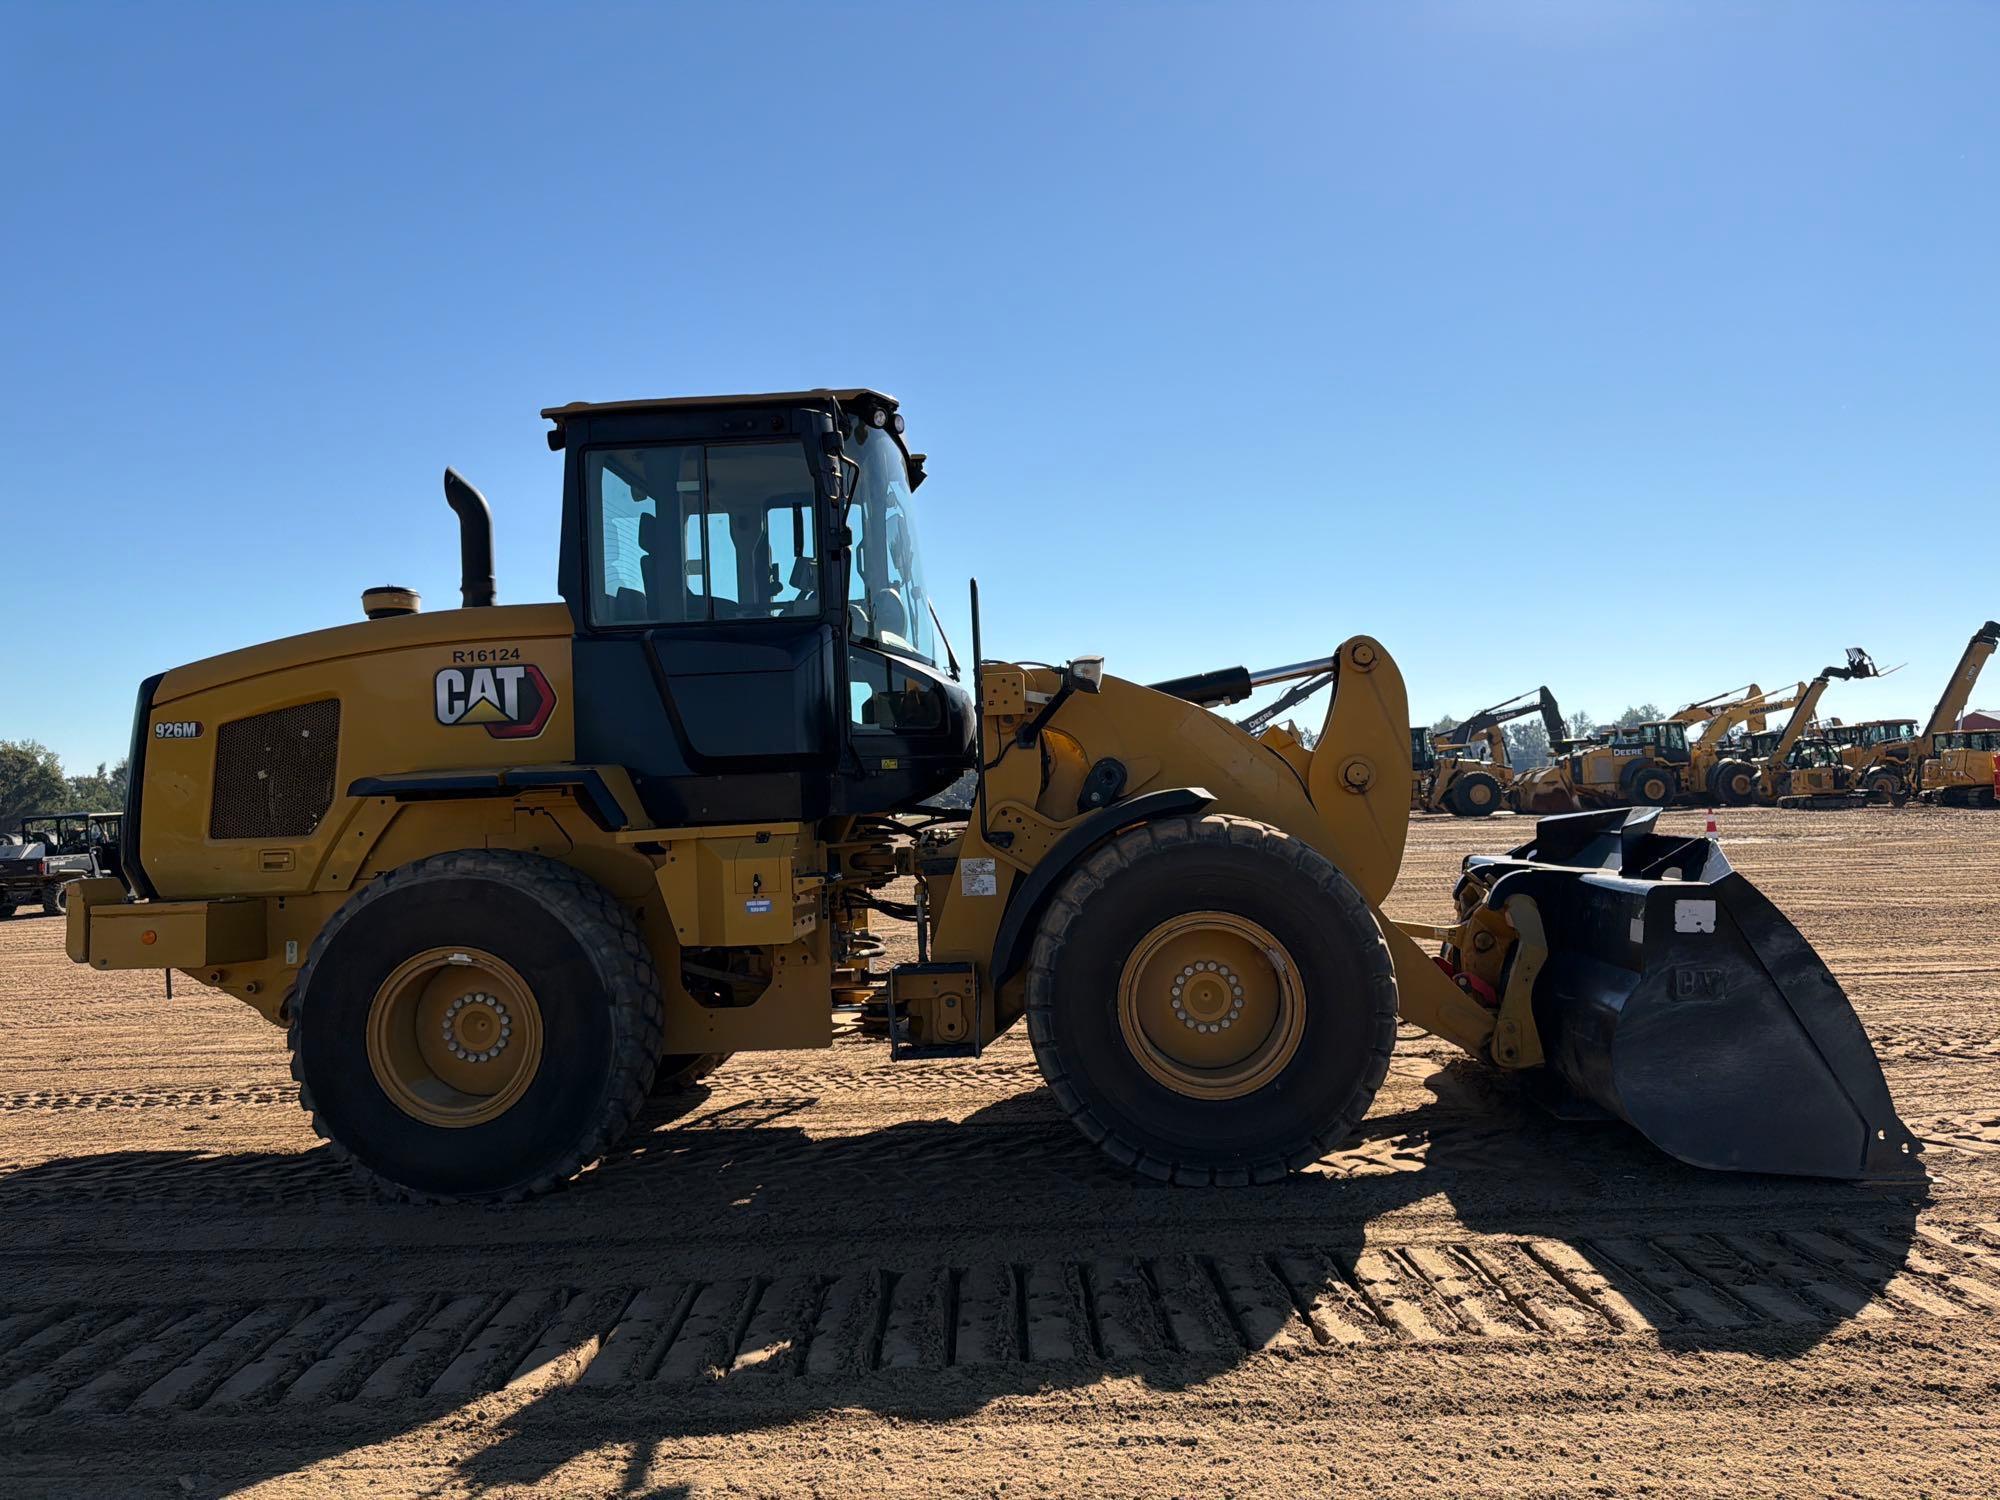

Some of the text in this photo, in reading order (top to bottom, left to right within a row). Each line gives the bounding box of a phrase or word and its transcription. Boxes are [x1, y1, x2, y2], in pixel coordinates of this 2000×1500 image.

[452, 648, 520, 663] R16124
[436, 666, 525, 724] CAT
[1248, 709, 1274, 728] DEERE
[155, 722, 196, 738] 926M
[1613, 748, 1643, 757] DEERE
